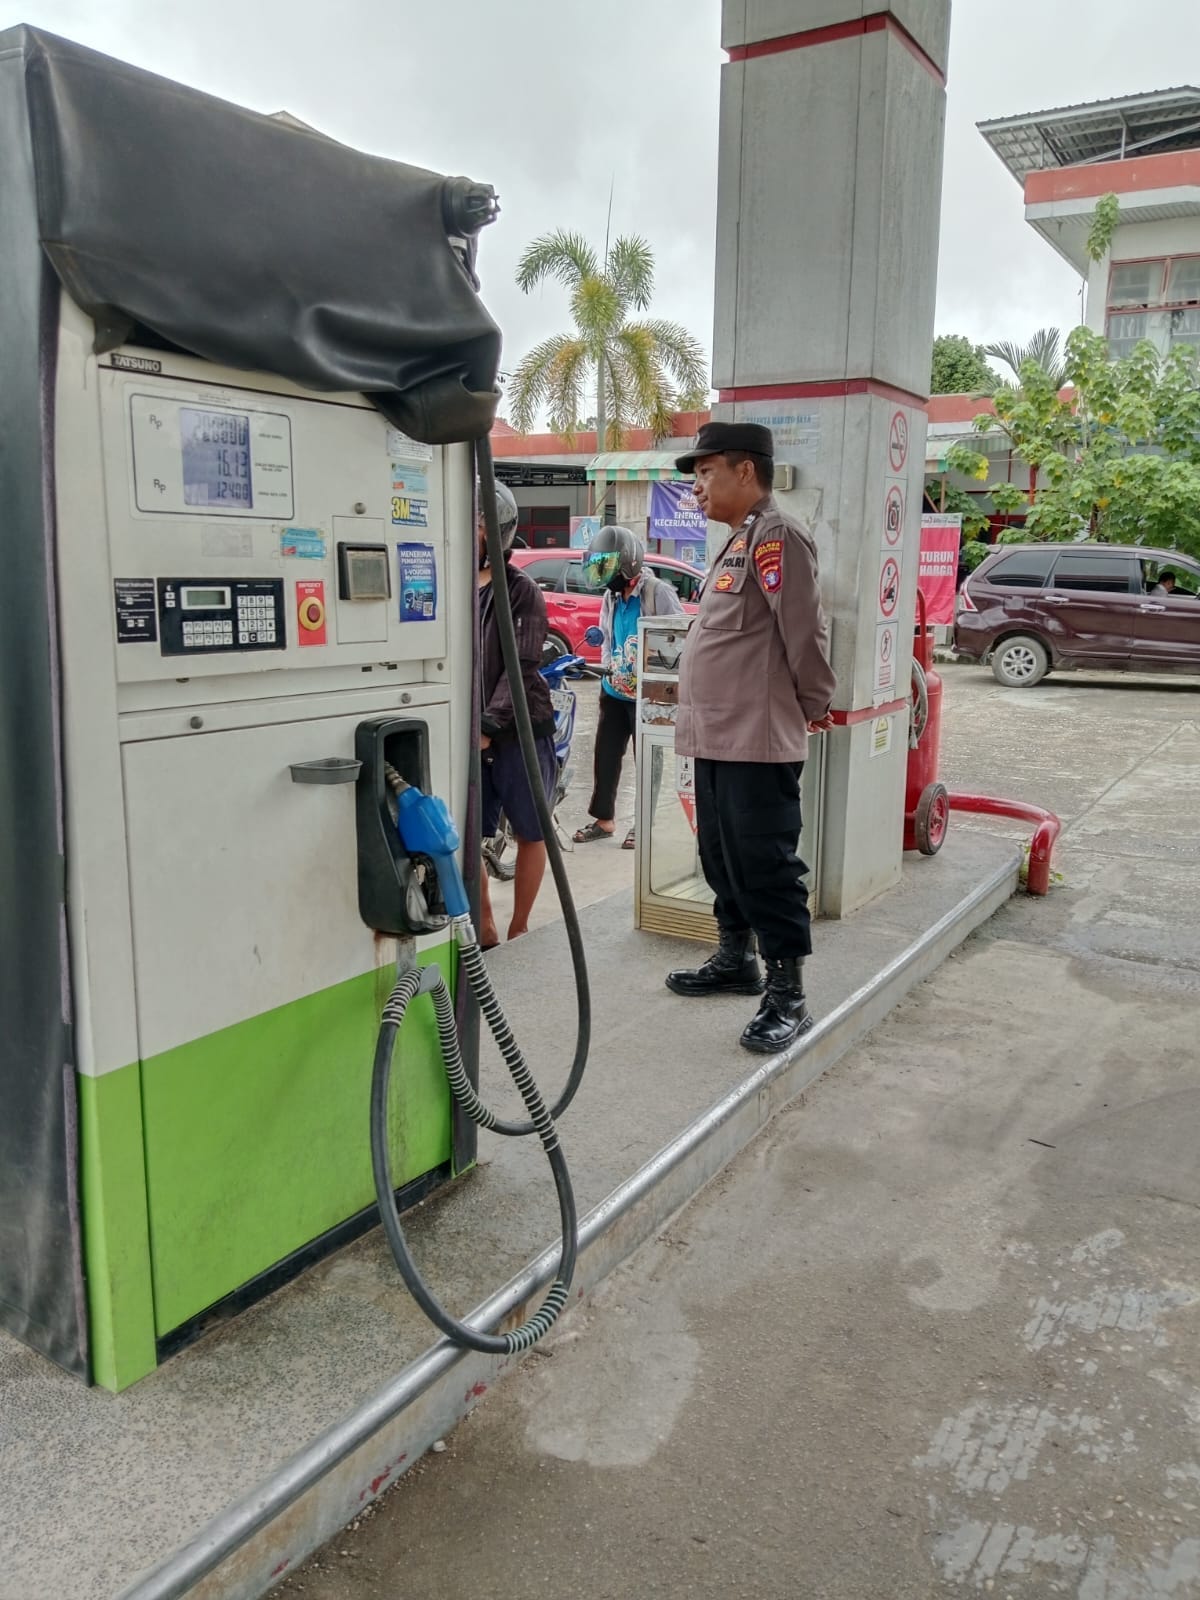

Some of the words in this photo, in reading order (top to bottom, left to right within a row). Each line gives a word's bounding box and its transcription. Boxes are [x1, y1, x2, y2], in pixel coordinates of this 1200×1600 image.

[113, 355, 160, 371] TATSUNO
[153, 478, 166, 493] Rp
[217, 481, 249, 500] 12400
[391, 496, 410, 520] 3M
[674, 511, 703, 520] ENERGI
[655, 518, 698, 528] KECERIAAN
[721, 556, 745, 568] POLRI
[920, 551, 954, 563] TURUN
[919, 564, 953, 576] HARGA
